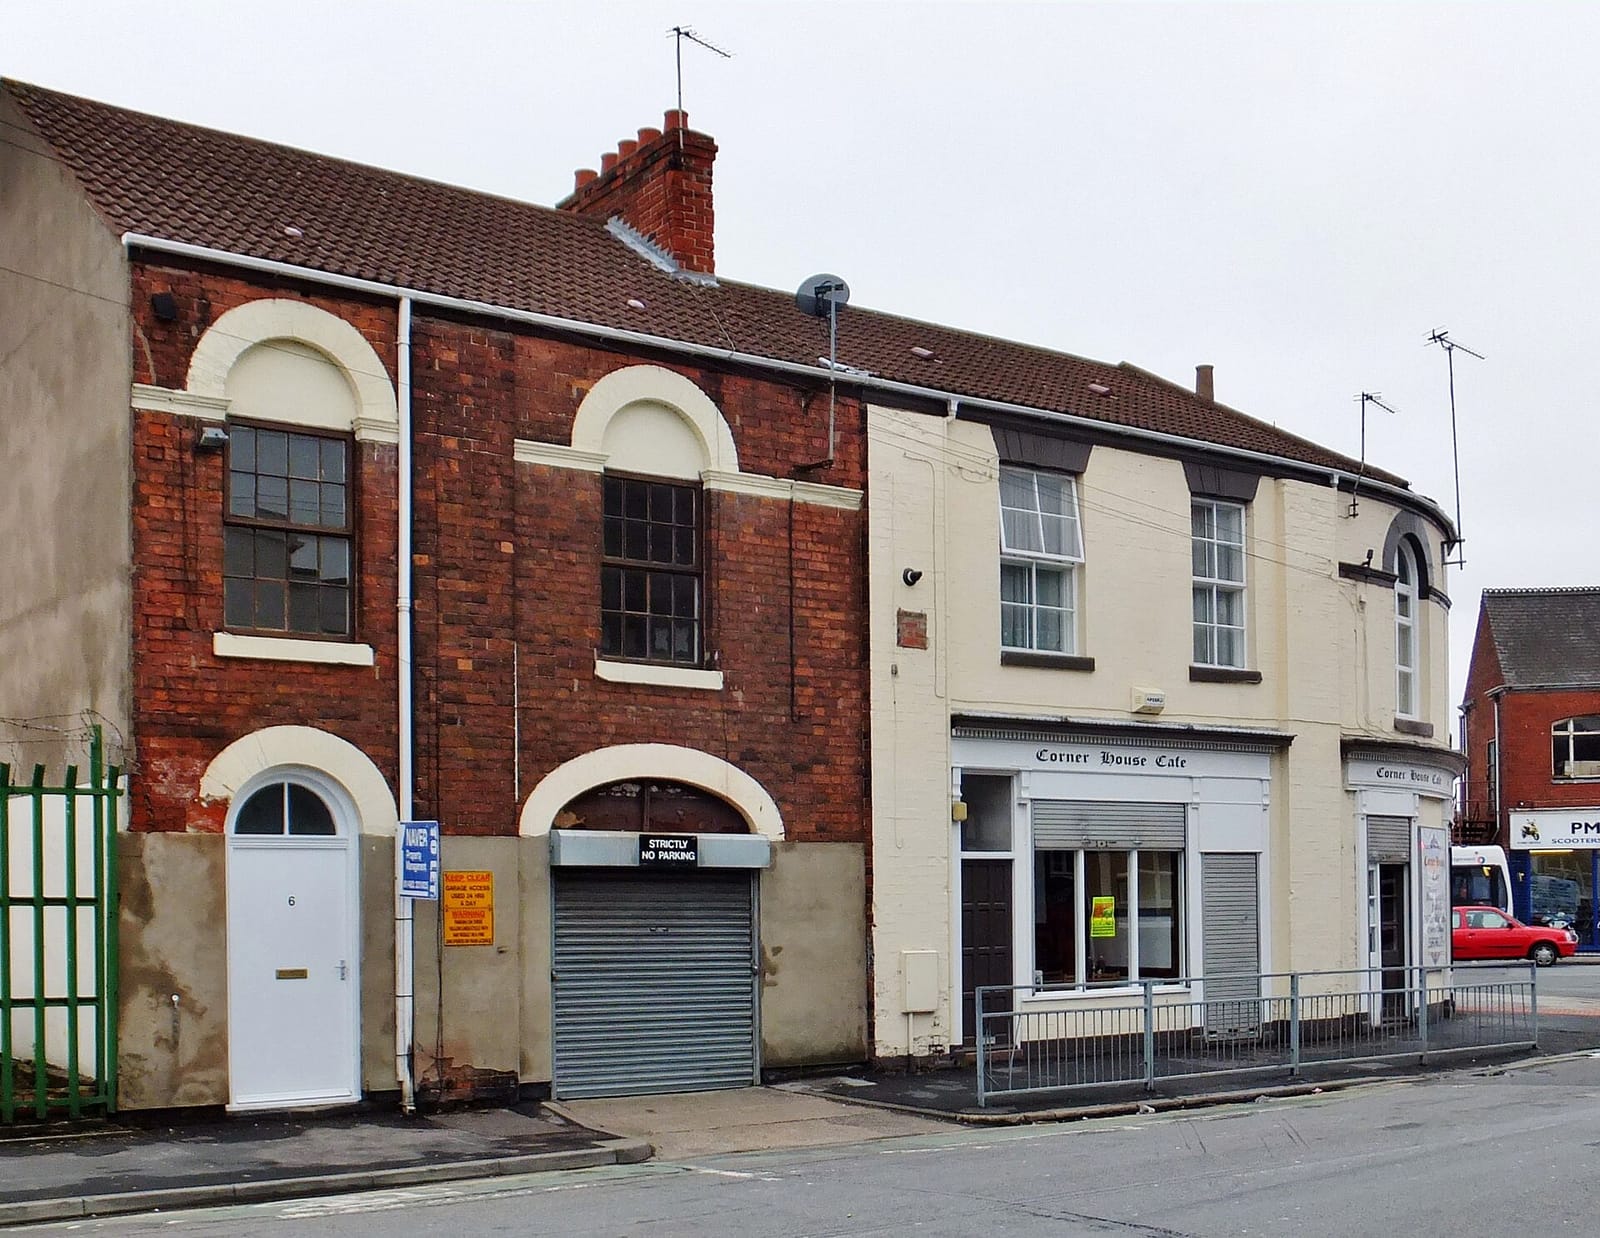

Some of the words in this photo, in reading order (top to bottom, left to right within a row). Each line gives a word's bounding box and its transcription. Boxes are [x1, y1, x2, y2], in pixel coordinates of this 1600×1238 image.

[1036, 749, 1090, 764] Corner
[1100, 751, 1147, 766] House
[1155, 755, 1187, 768] Cafe
[1376, 767, 1405, 780] Corner
[648, 839, 688, 849] STRICTLY
[641, 850, 656, 860] NO
[658, 850, 696, 860] PARKING
[445, 874, 465, 883] KEEP
[467, 874, 491, 882] CLEAR
[288, 896, 296, 906] 6
[451, 911, 485, 919] WARNING
